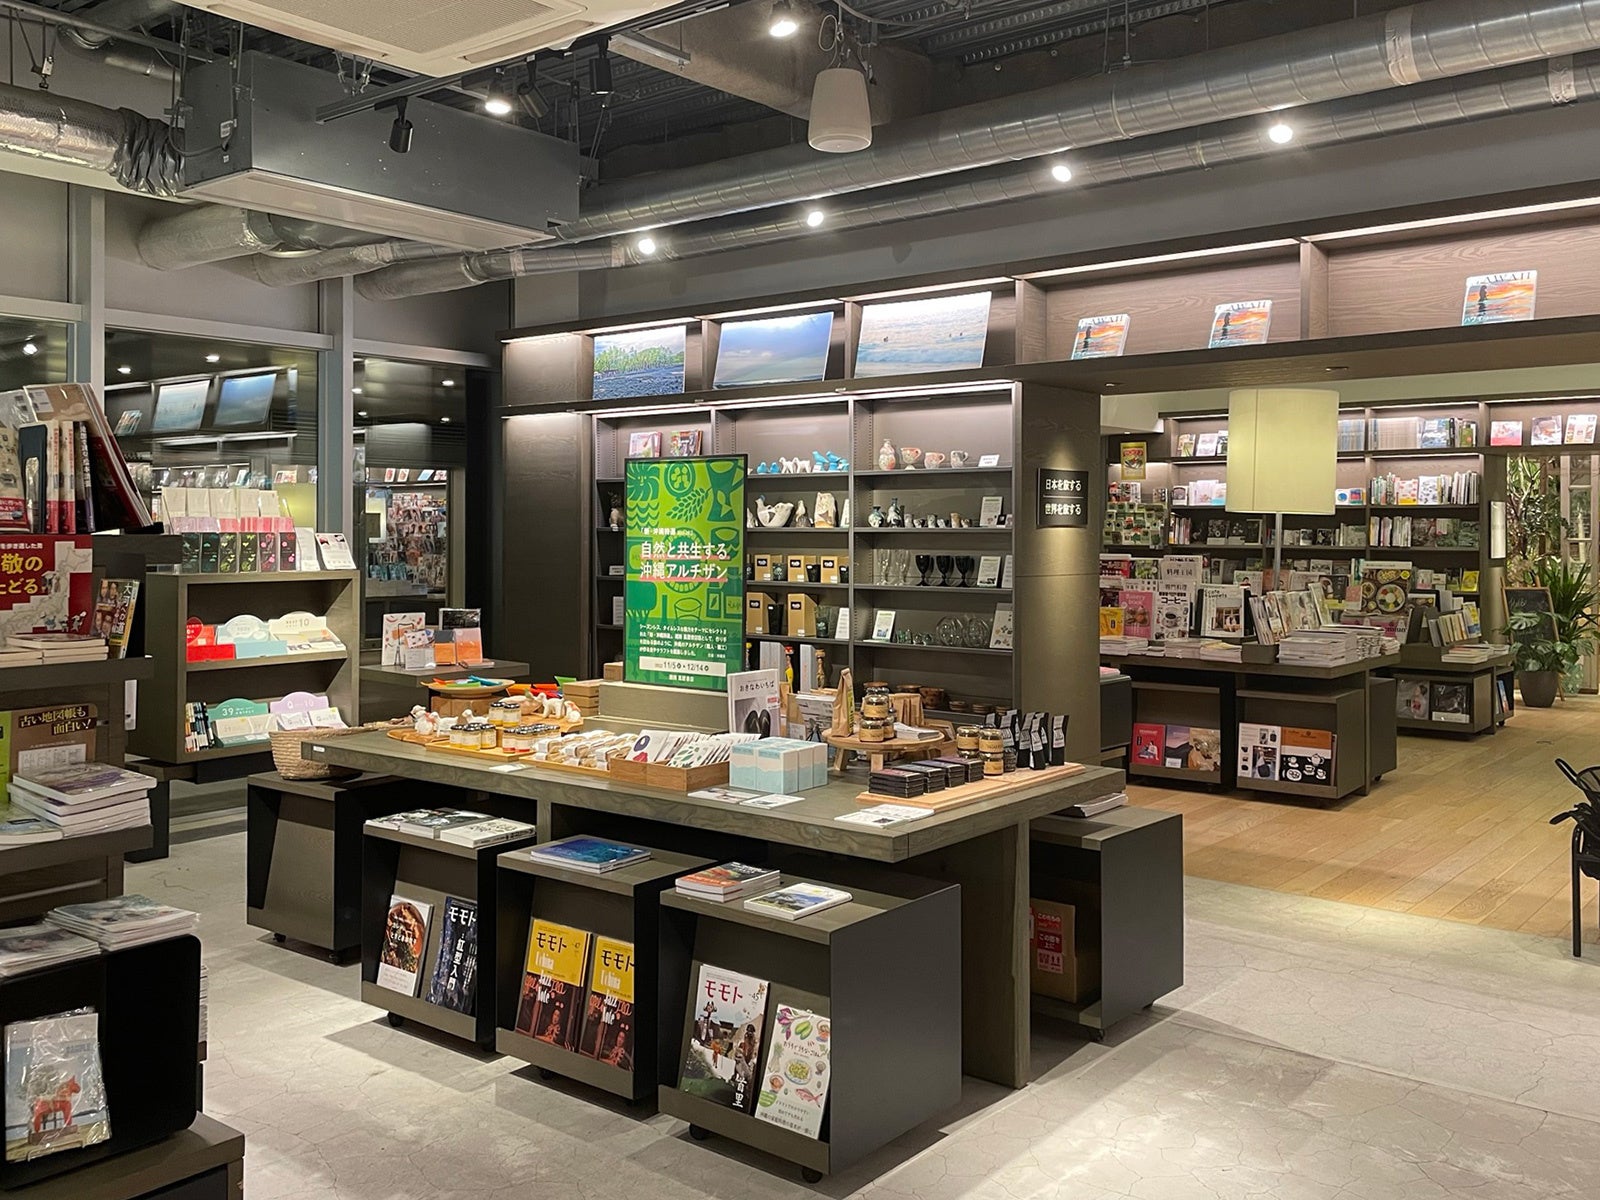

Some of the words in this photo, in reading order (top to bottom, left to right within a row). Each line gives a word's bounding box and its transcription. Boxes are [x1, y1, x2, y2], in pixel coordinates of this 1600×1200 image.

[641, 540, 728, 559] 自然と共生する
[1, 553, 43, 574] 敬の
[640, 561, 728, 579] 沖縄アルチザン
[1161, 596, 1187, 605] コーヒー
[739, 680, 775, 692] おきなわいちば
[20, 706, 87, 728] 古い地図帳も
[53, 718, 92, 735] 面白い!
[448, 906, 477, 927] モモト
[536, 932, 567, 953] モモト
[446, 938, 466, 991] 紅型入門
[600, 949, 634, 972] モモト
[705, 980, 743, 1004] モモト
[732, 1074, 748, 1108] 首里
